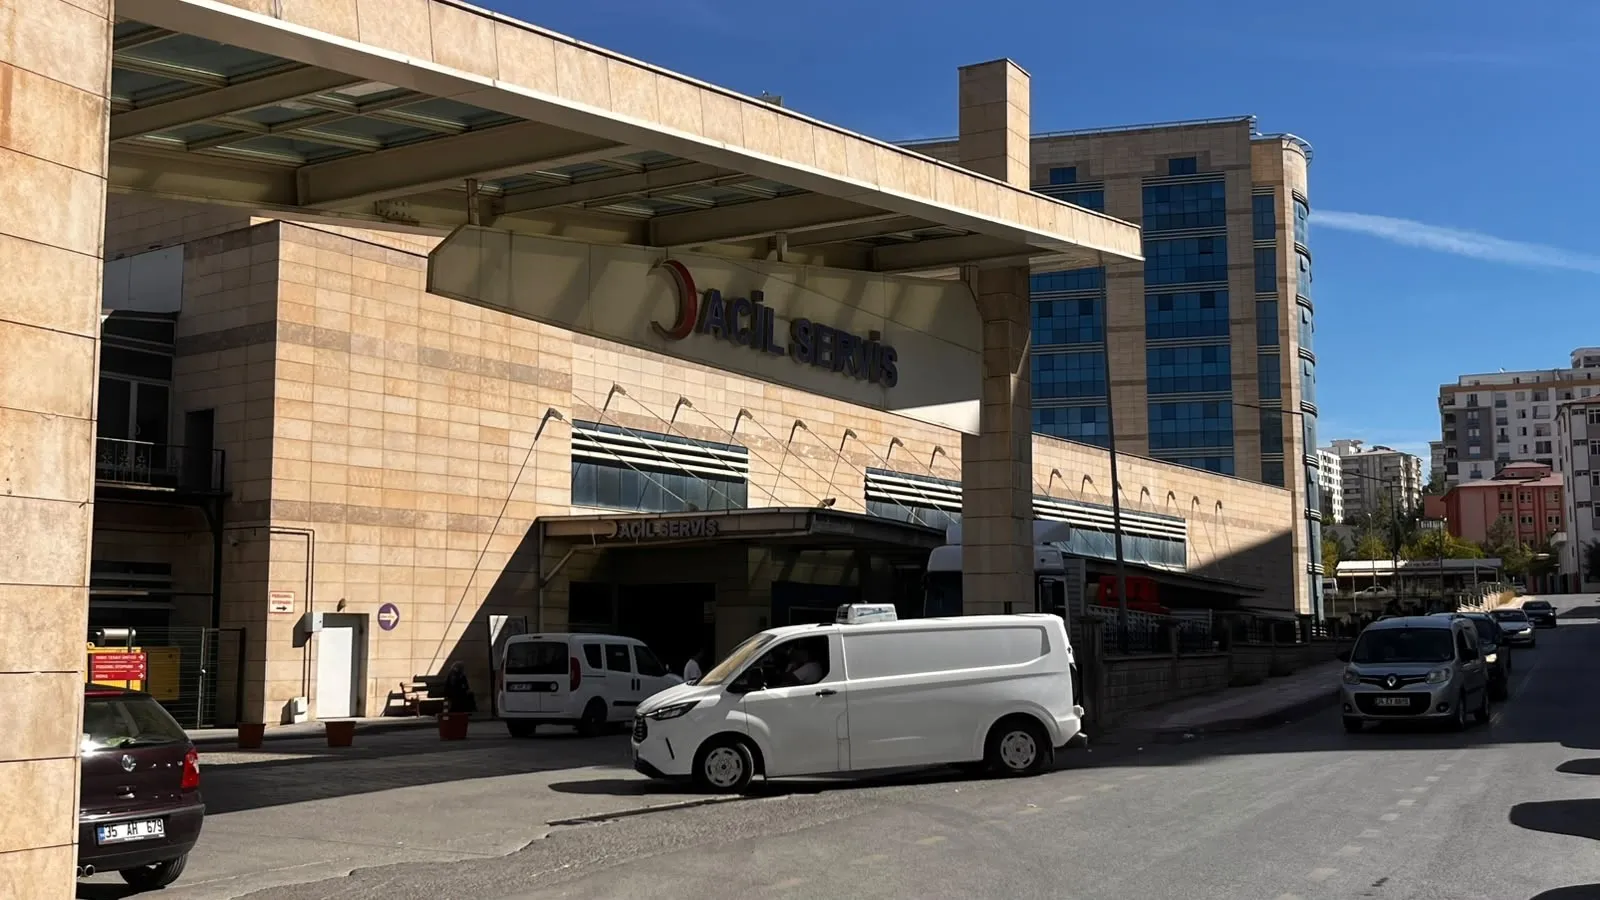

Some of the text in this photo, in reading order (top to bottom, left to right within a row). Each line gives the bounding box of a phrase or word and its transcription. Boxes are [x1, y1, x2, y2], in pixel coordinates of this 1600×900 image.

[695, 288, 898, 388] ACİL SERVİS
[105, 825, 118, 838] 35
[127, 822, 138, 835] AH
[146, 819, 163, 833] 679
